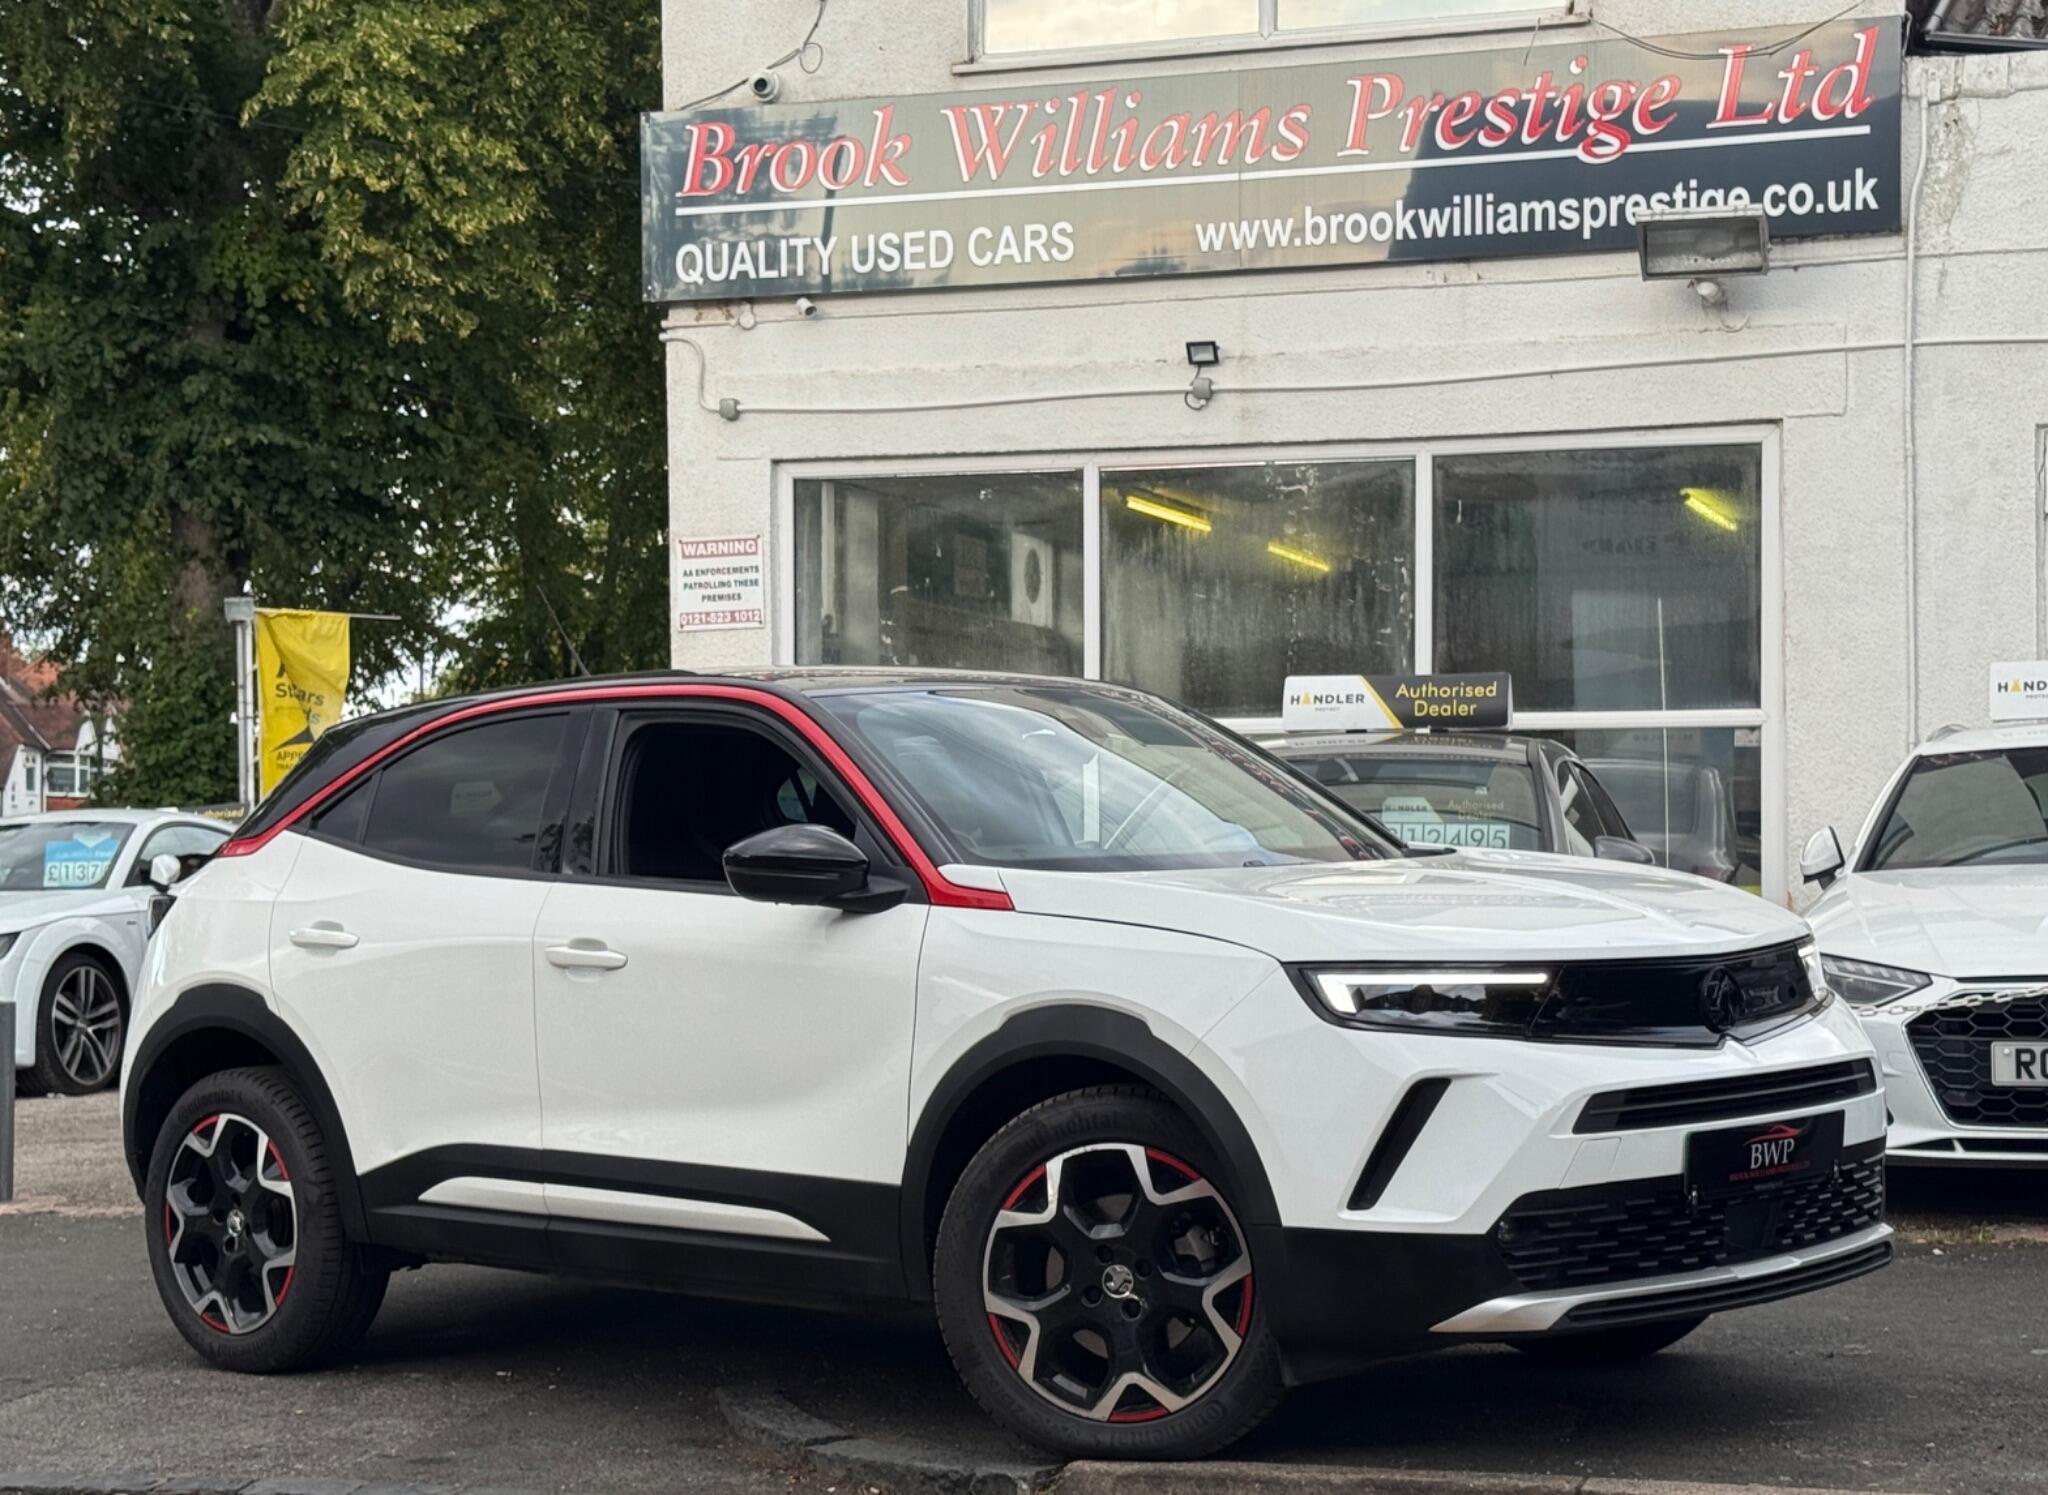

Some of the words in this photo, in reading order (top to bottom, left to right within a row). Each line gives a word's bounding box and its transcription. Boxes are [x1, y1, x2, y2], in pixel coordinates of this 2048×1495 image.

[676, 104, 913, 198] Brook
[940, 88, 1312, 181] Williams
[1337, 54, 1682, 164] Prestige
[1705, 26, 1880, 130] Ltd
[675, 235, 838, 284] QUALITY
[851, 229, 954, 275] USED
[967, 221, 1075, 266] CARS
[683, 540, 757, 557] WARNING
[683, 569, 694, 577] AA
[695, 565, 759, 577] ENFORCEMENTS
[683, 580, 732, 591] PATROLLING
[734, 578, 759, 588] THESE
[701, 592, 742, 602] PREMISES
[734, 610, 760, 622] 1012
[1395, 681, 1497, 698] Authorised
[1291, 693, 1365, 705] HANDLER
[1414, 700, 1477, 717] Dealer
[1390, 828, 1507, 849] 12495
[1750, 1138, 1795, 1169] BWP
